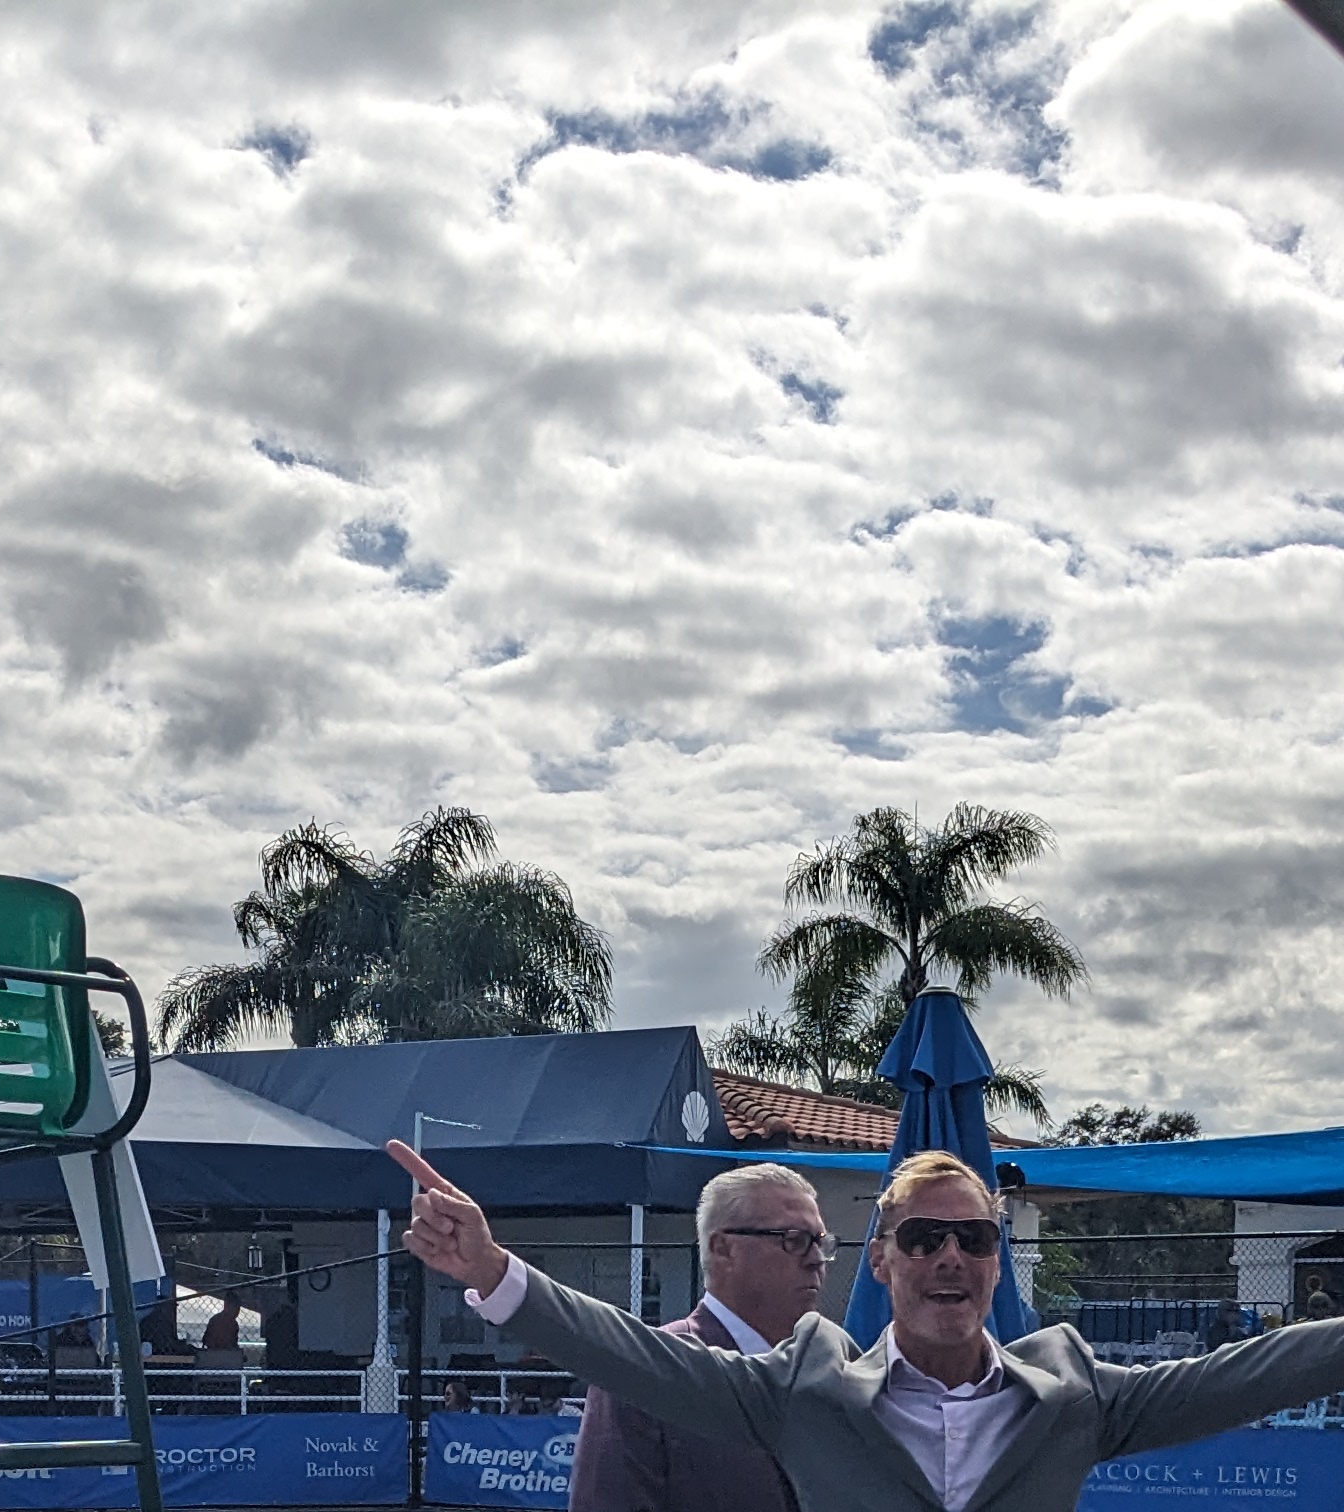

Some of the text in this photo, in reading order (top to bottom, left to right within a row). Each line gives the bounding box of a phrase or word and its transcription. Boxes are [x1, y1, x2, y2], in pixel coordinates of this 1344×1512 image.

[8, 1315, 31, 1327] HOM
[305, 1437, 379, 1454] Novak &
[154, 1447, 256, 1465] ROCTOR
[443, 1441, 539, 1472] Cheney
[158, 1463, 256, 1473] NSTRUCTION
[306, 1461, 375, 1478] Barhorst
[1087, 1463, 1178, 1482] ACOCK
[1217, 1466, 1298, 1485] LEWIS
[479, 1467, 574, 1493] Brothe
[1145, 1486, 1209, 1496] ARCHITECTURE
[1265, 1490, 1297, 1498] DESIGN
